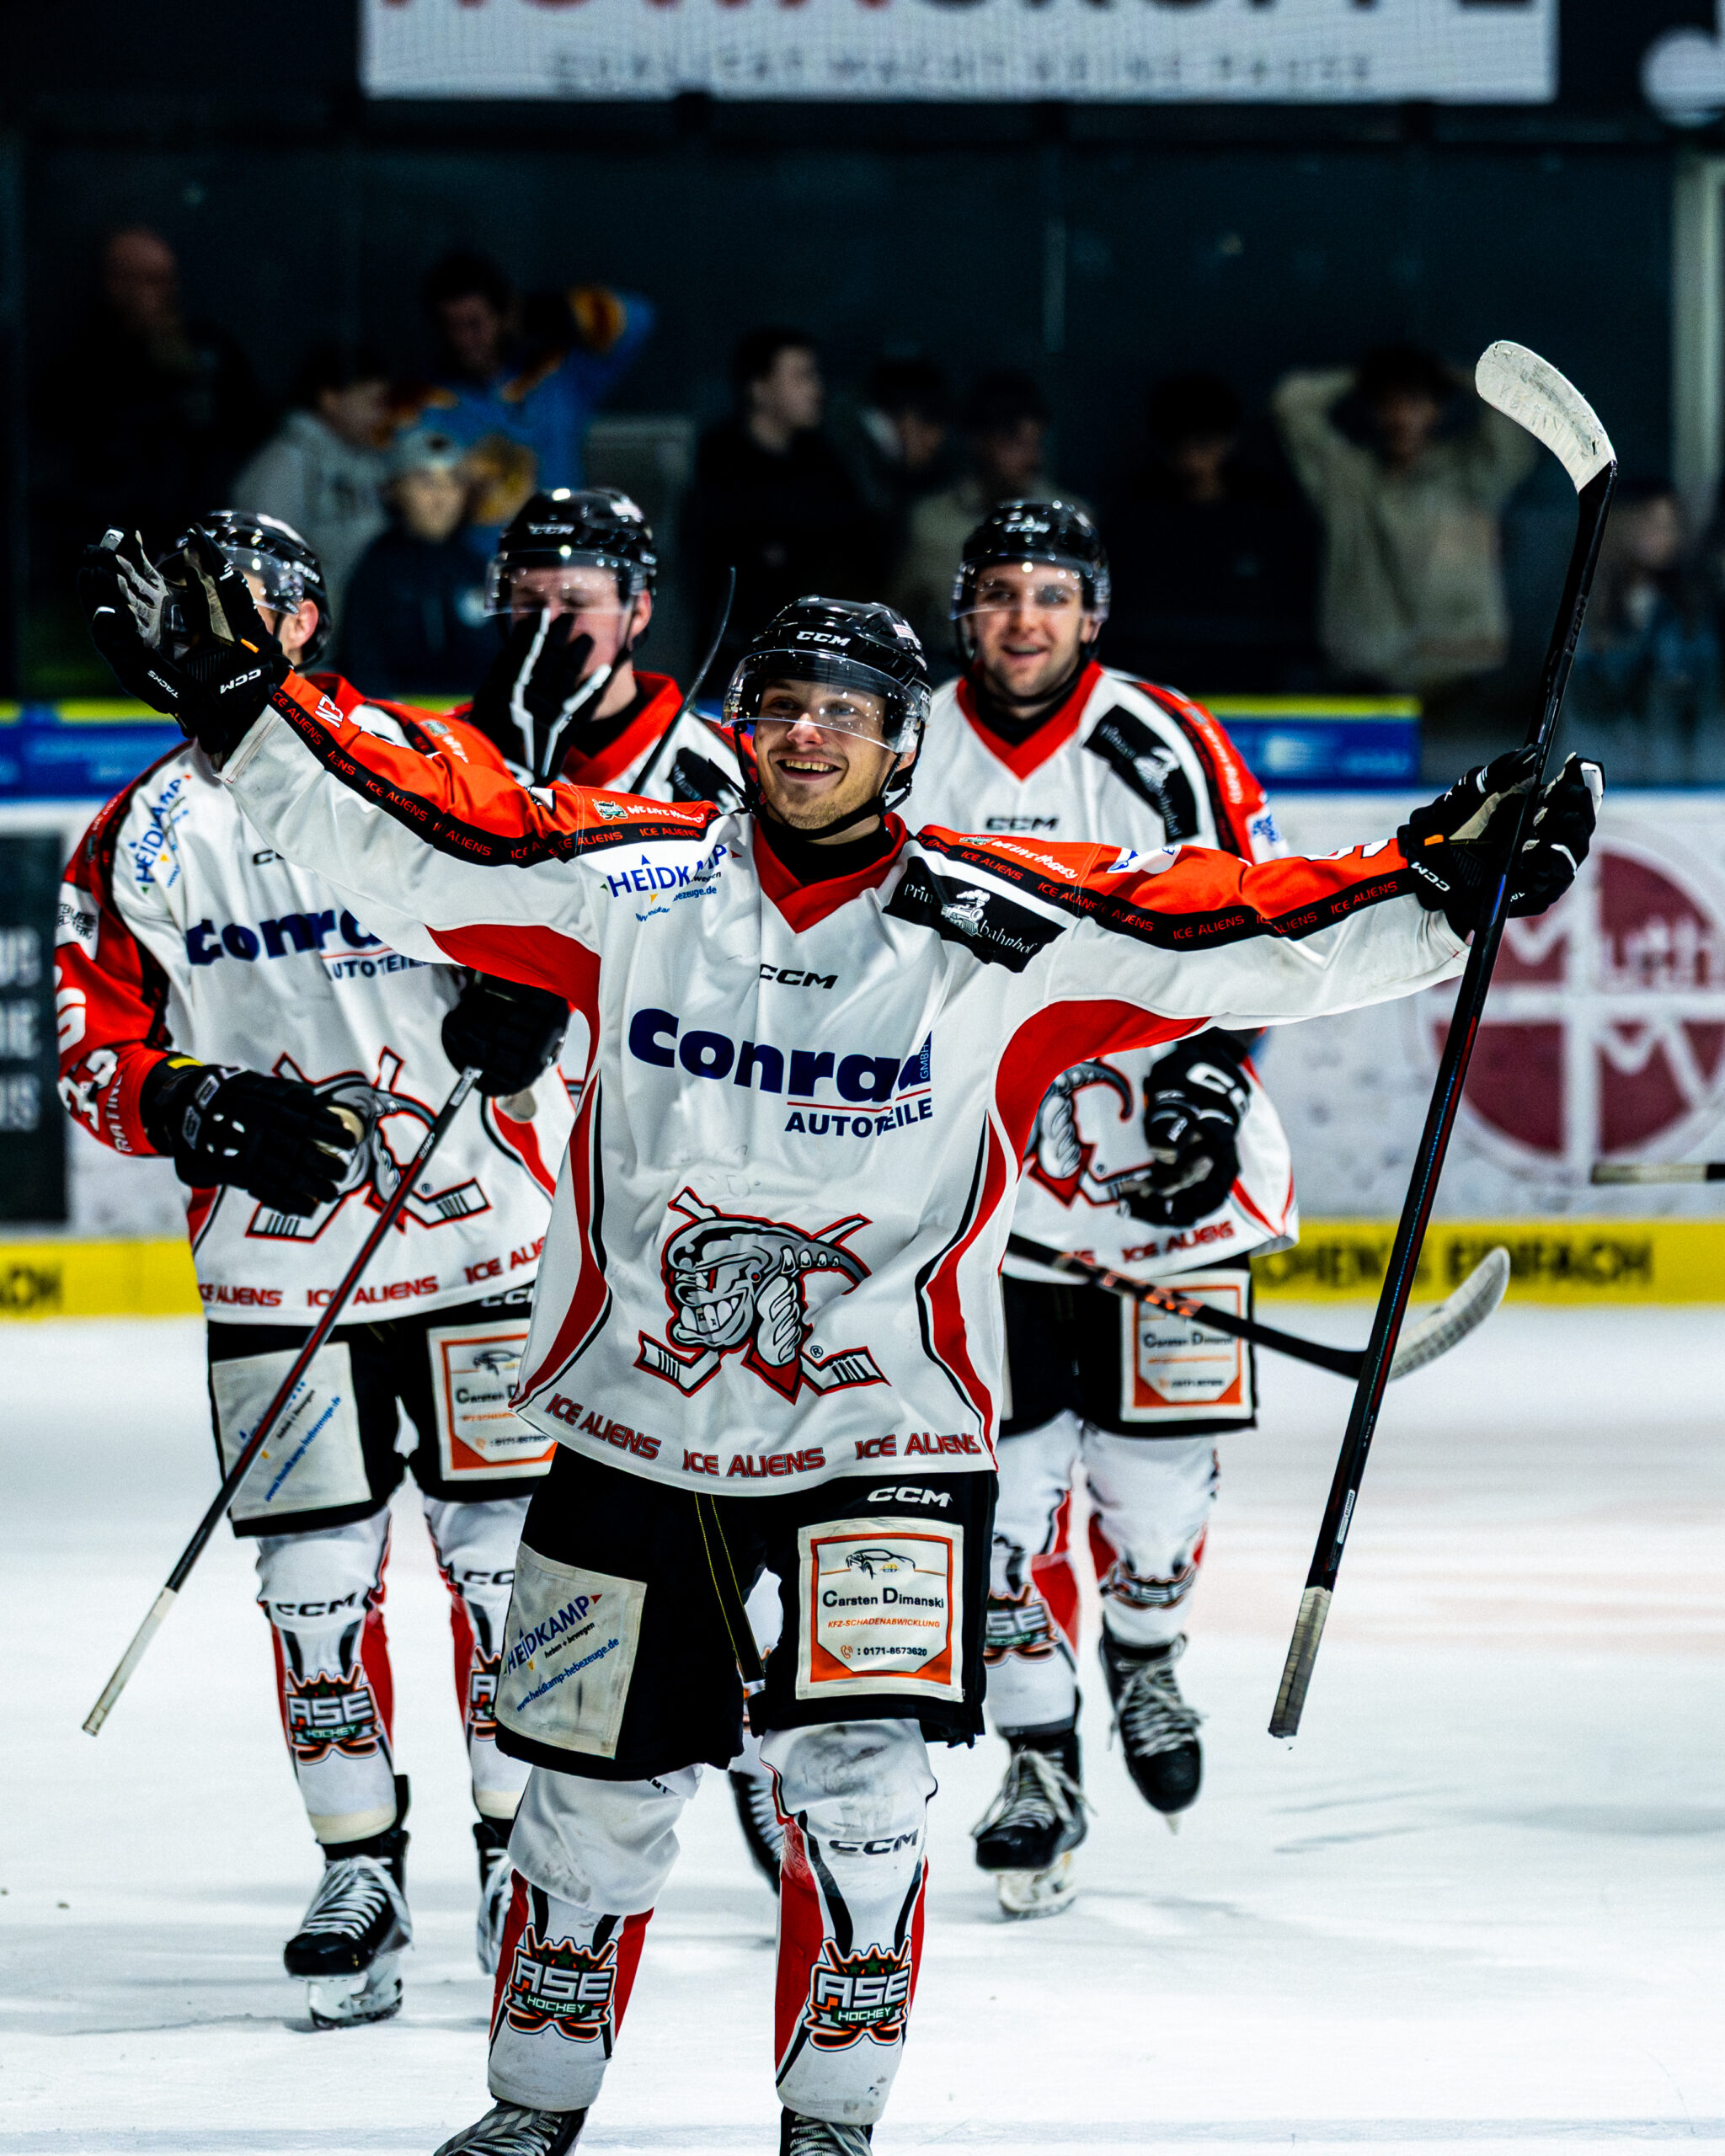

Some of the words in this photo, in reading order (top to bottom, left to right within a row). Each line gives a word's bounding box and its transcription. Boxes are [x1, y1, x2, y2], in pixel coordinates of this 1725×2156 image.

[796, 631, 852, 647] CCM
[220, 669, 262, 695] CCM
[286, 706, 323, 745] ALIENS
[366, 780, 384, 796] ICE
[385, 791, 429, 822] ALIENS
[446, 828, 492, 857] ALIENS
[577, 831, 623, 846] ALIENS
[639, 827, 659, 837] ICE
[662, 828, 701, 838] ALIENS
[985, 817, 1060, 830] CCM
[1411, 862, 1450, 892] CCM
[961, 851, 980, 862] ICE
[980, 857, 1024, 881] ALIENS
[1037, 882, 1059, 898] ICE
[1173, 927, 1194, 940] ICE
[1197, 915, 1245, 937] ALIENS
[1331, 899, 1351, 915] ICE
[1353, 880, 1398, 905] ALIENS
[760, 963, 838, 990] CCM
[1122, 1242, 1161, 1262] ICE
[216, 1285, 283, 1306] ALIENS
[352, 1275, 439, 1305] ALIENS
[463, 1257, 504, 1285] ICE
[544, 1392, 585, 1427] ICE
[581, 1412, 663, 1460] ALIENS
[682, 1449, 720, 1476] ICE
[727, 1448, 827, 1478] ALIENS
[856, 1434, 897, 1460] ICE
[904, 1432, 983, 1457] ALIENS
[867, 1486, 953, 1508] CCM
[464, 1570, 515, 1585] CC
[276, 1592, 357, 1617] CCM
[822, 1590, 879, 1608] Carsten
[883, 1588, 944, 1609] Dimanski
[507, 1595, 590, 1676] HEIDKAMP
[828, 1618, 941, 1629] KFZ-SCHADENABWICKLUNG
[863, 1646, 927, 1657] 0171-8573620
[288, 1689, 375, 1727] ASE
[829, 1828, 919, 1855] CCM
[514, 1955, 611, 2001] ASE
[817, 1968, 909, 2009] ASE
[526, 1994, 586, 2014] HOCKEY
[838, 2008, 893, 2022] HOCKEY
